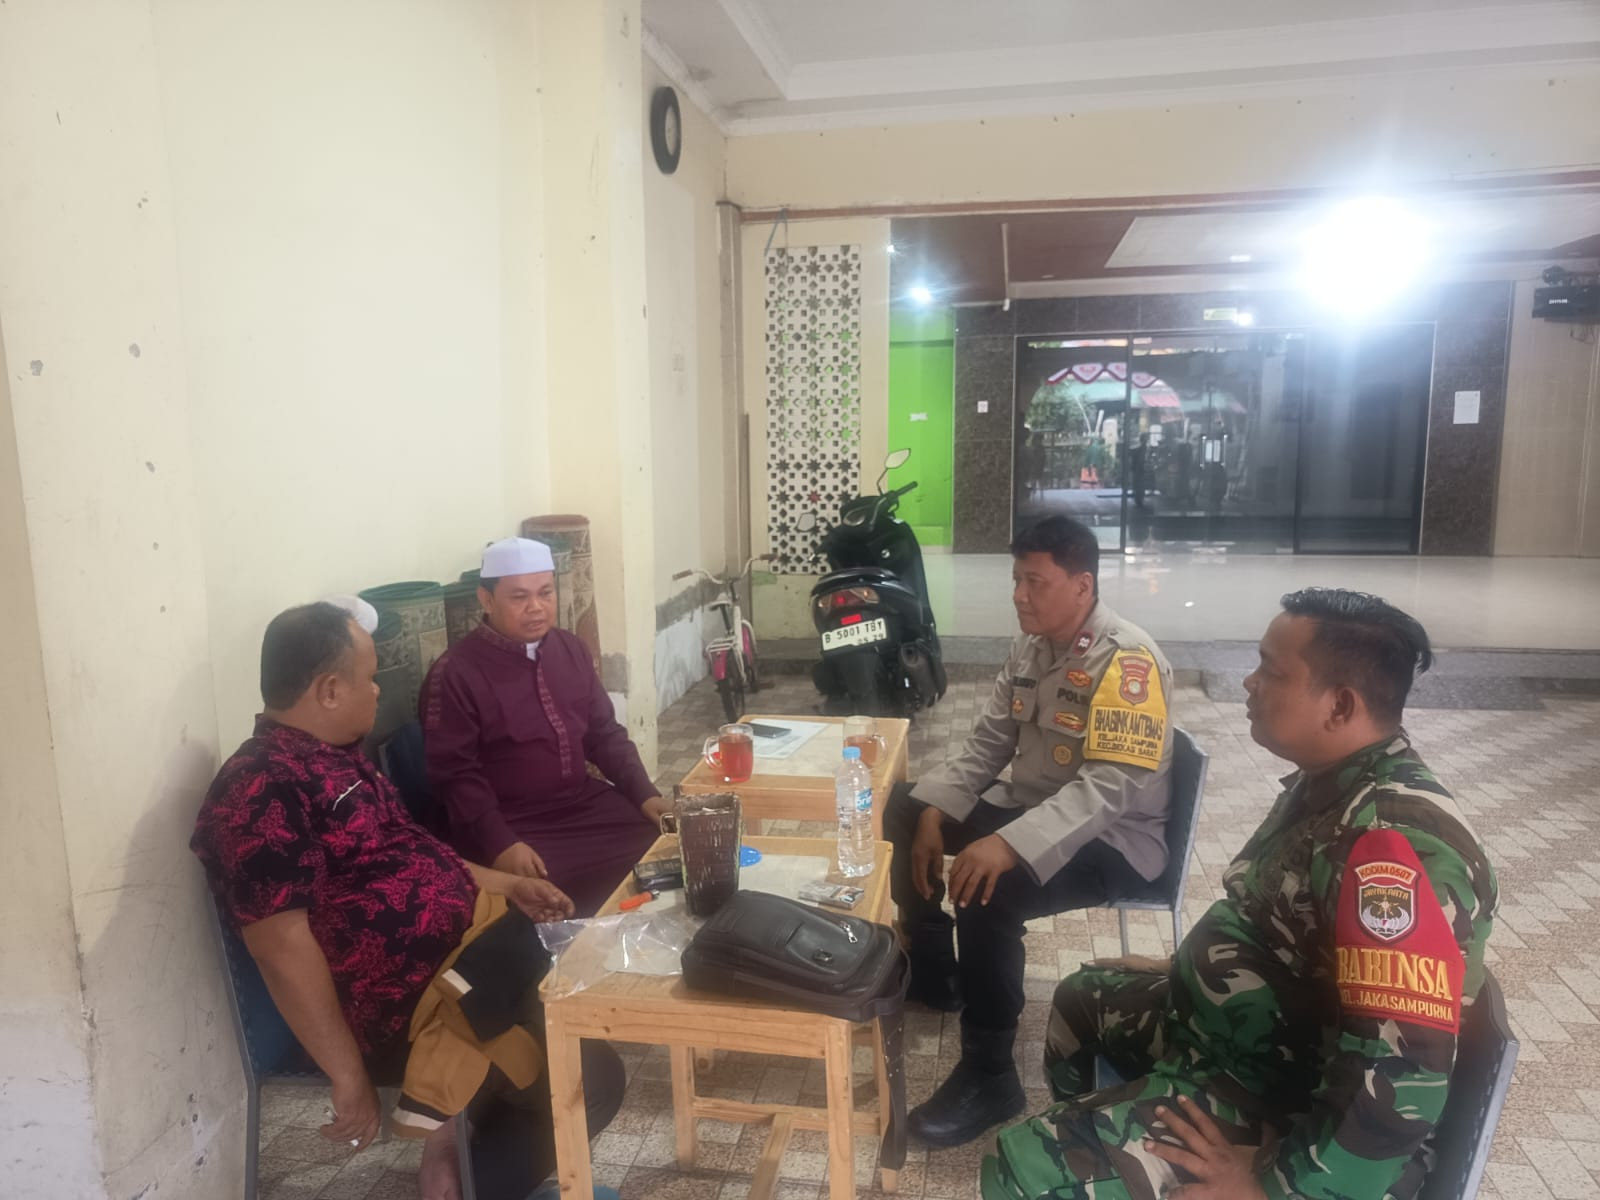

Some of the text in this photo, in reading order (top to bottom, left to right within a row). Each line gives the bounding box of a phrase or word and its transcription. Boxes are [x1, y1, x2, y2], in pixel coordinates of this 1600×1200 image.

[825, 634, 831, 643] B
[837, 627, 860, 640] 5001
[1336, 947, 1453, 1001] BABINSA
